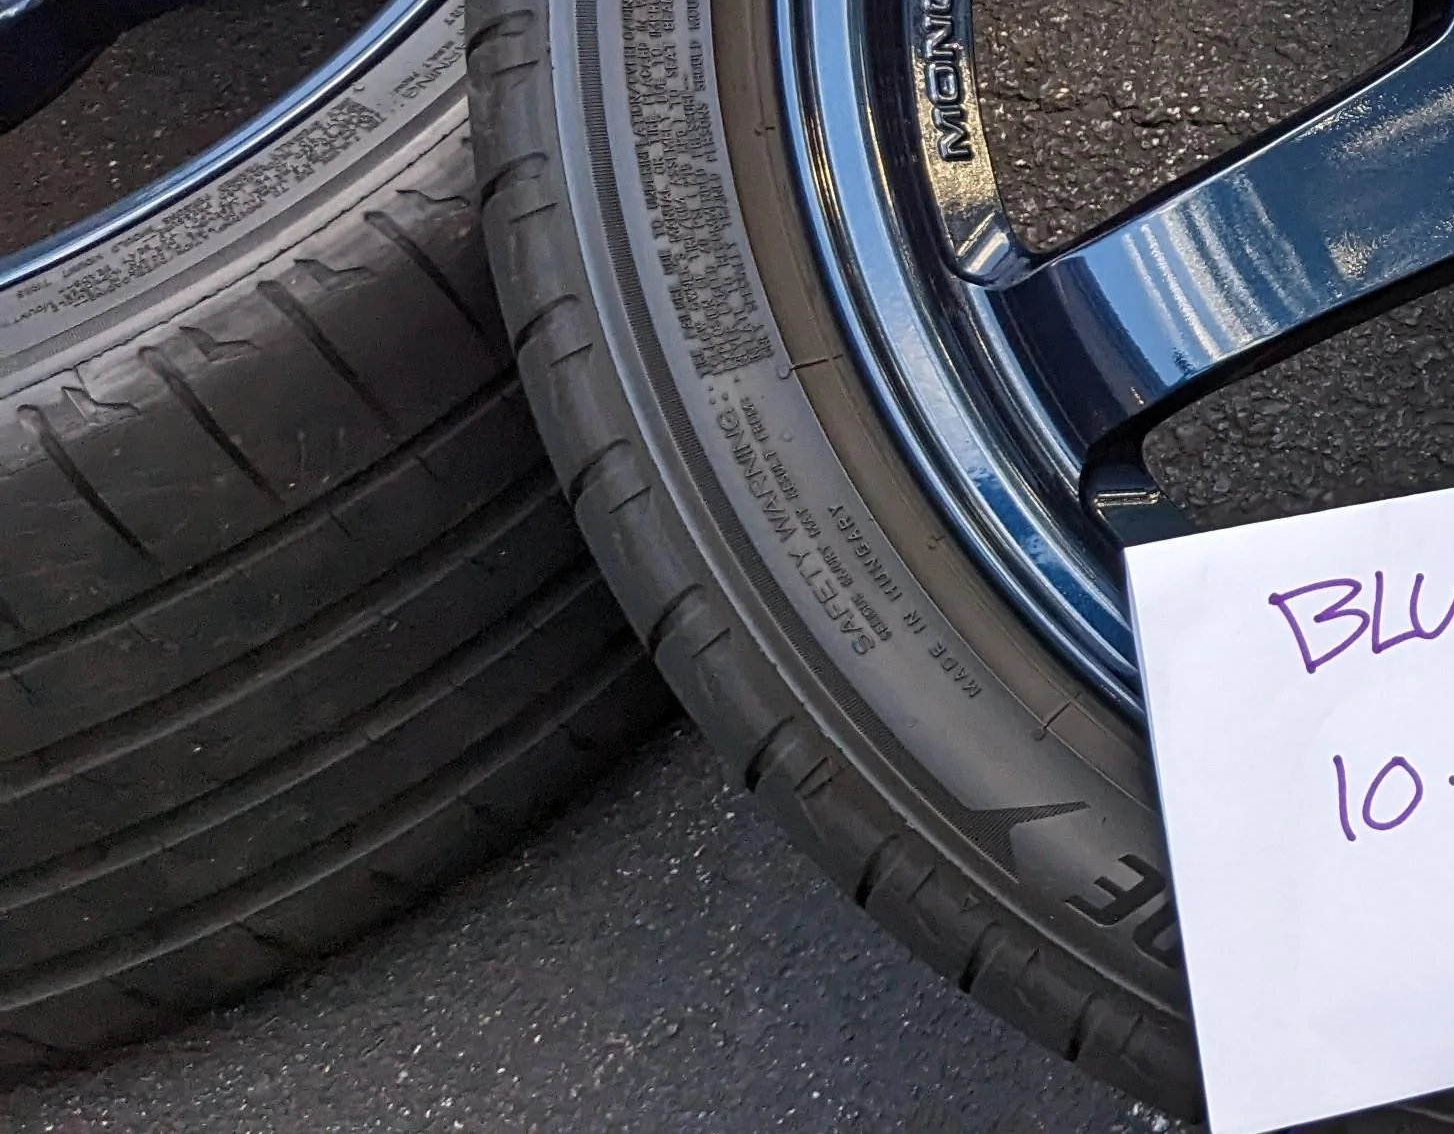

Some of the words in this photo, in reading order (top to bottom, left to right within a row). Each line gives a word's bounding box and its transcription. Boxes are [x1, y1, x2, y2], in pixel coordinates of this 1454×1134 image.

[822, 497, 906, 606] HUNGARY
[783, 540, 878, 660] SAFETY
[899, 606, 930, 637] IN
[925, 639, 985, 702] MADE
